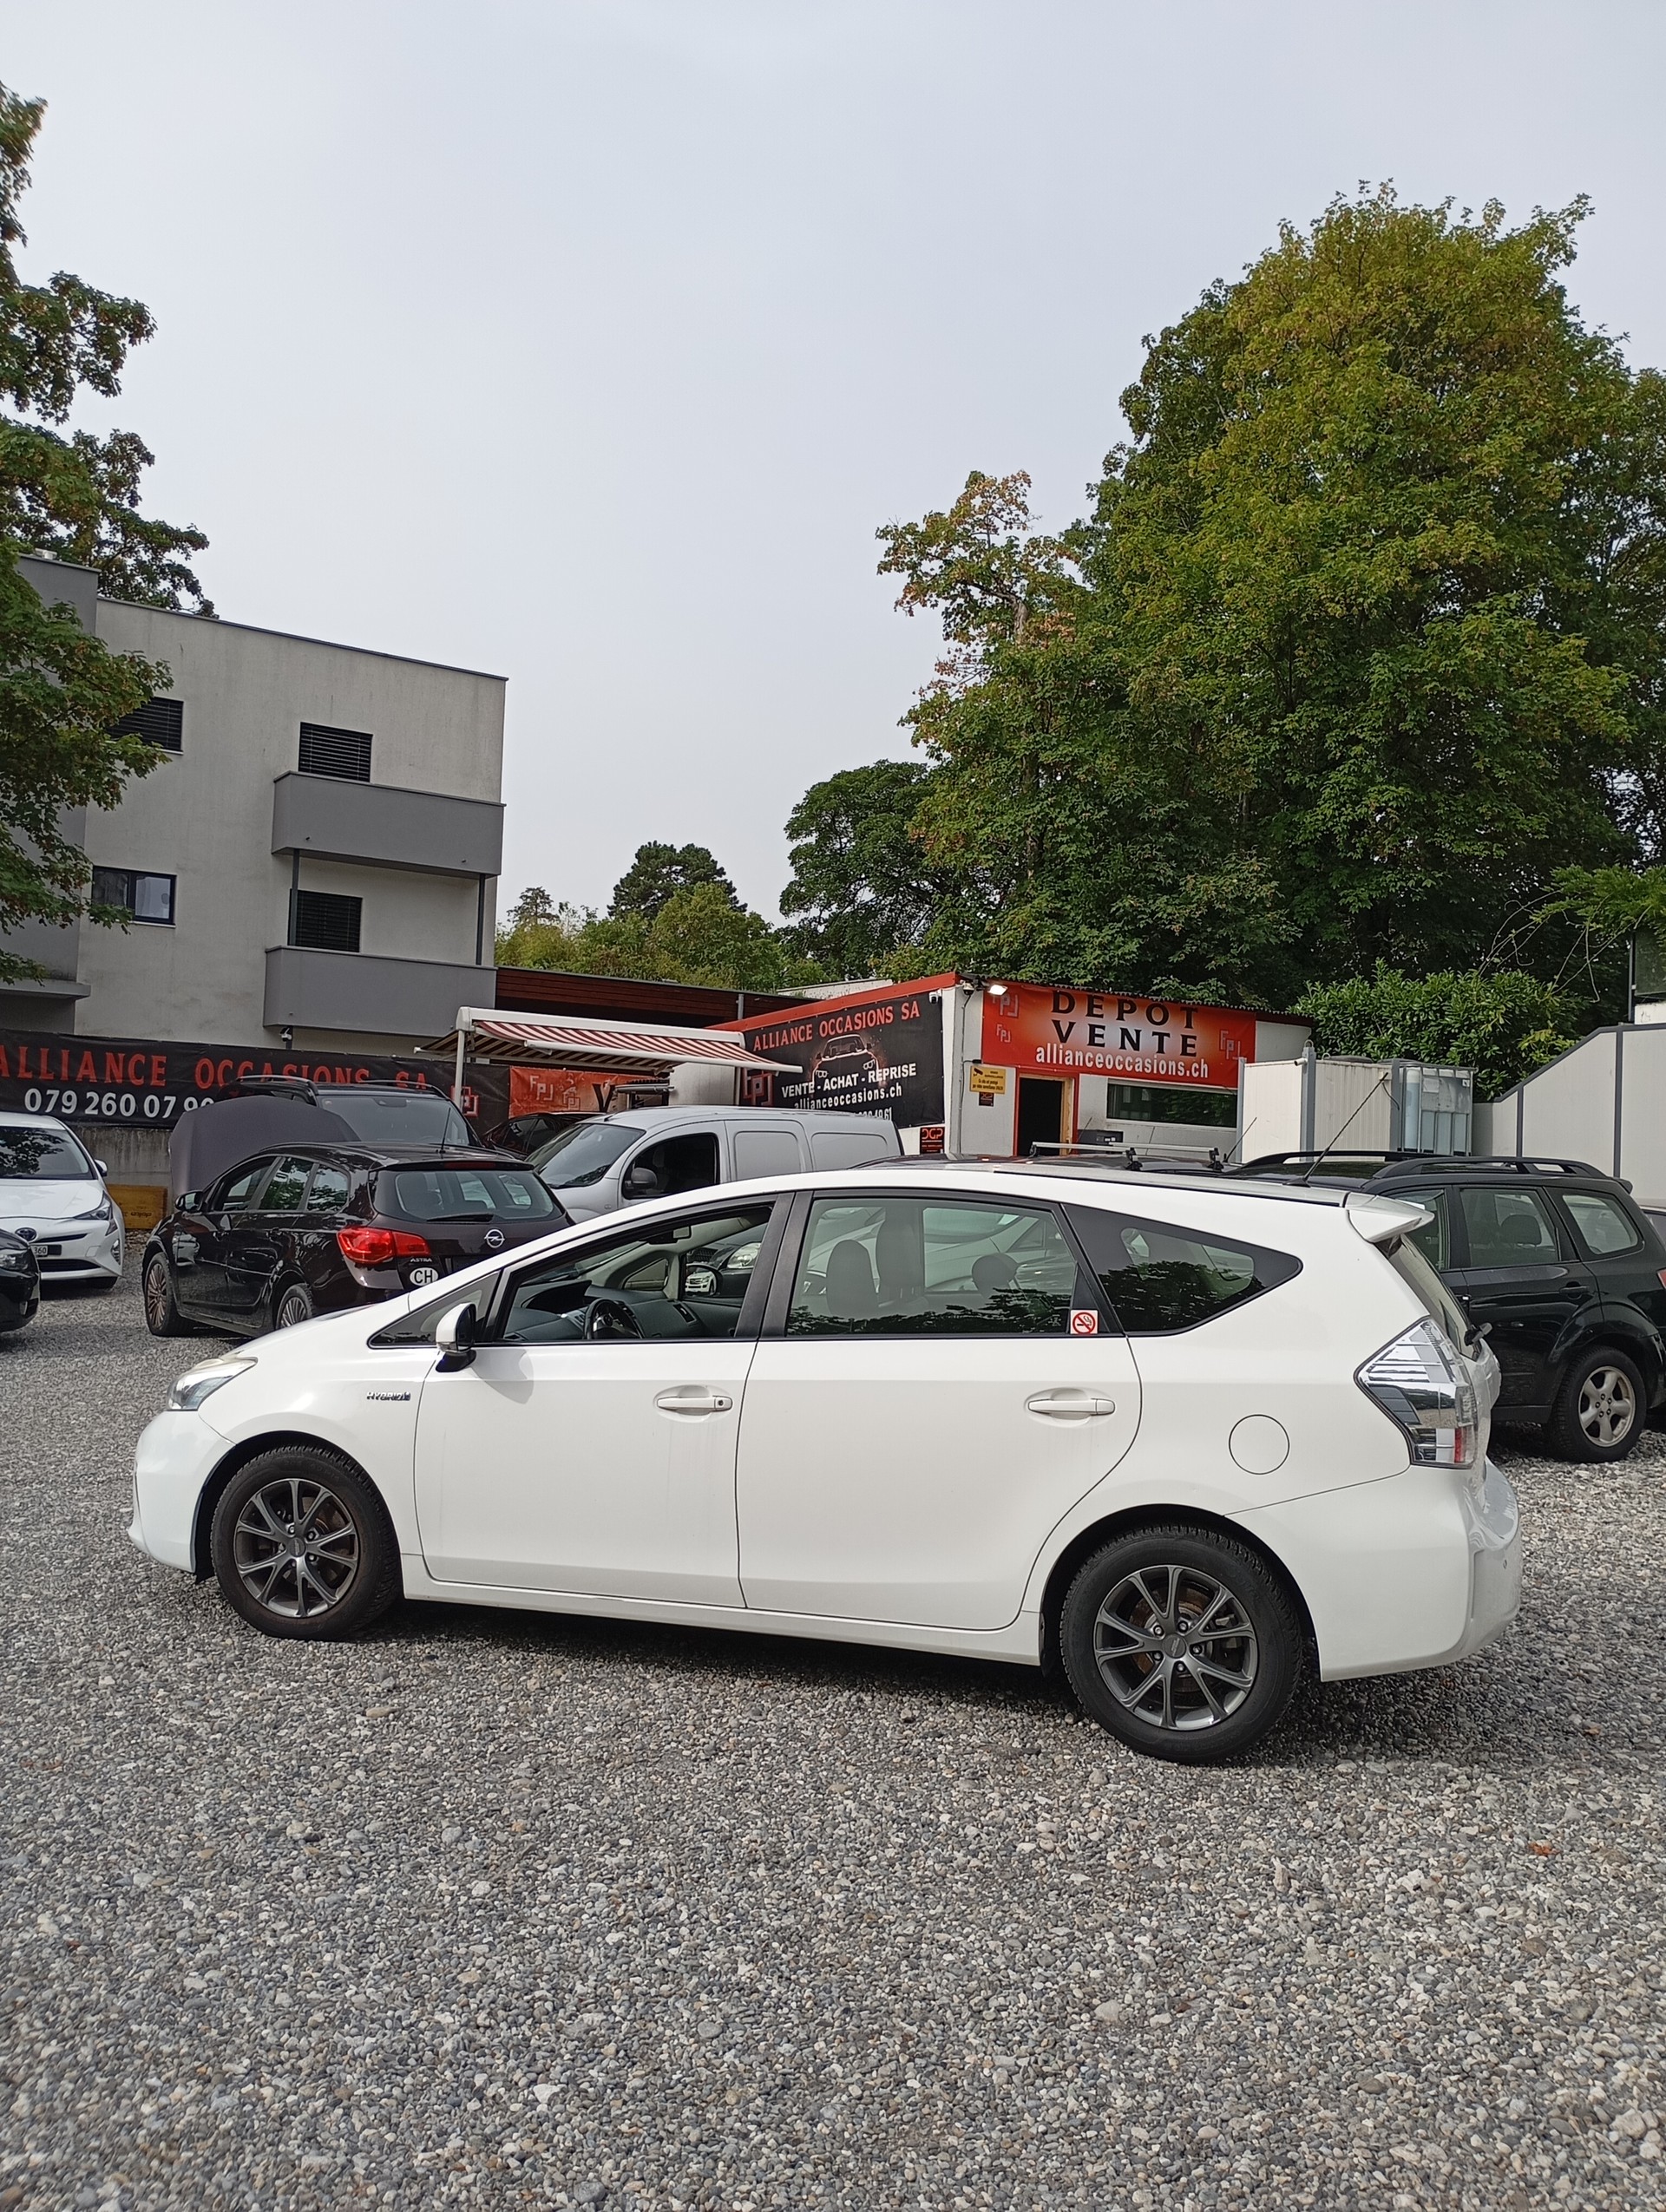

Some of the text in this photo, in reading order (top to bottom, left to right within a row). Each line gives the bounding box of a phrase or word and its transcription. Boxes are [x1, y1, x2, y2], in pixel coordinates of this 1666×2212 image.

[753, 1000, 920, 1052] ALLIANCE OCCASIONS SA
[1052, 991, 1198, 1029] DEPOT
[1052, 1019, 1197, 1057] VENTE
[1035, 1043, 1209, 1078] allianceoccasions.ch
[782, 1082, 815, 1098] VENTE
[823, 1073, 859, 1091] ACHAT
[868, 1063, 916, 1083] REPRISE
[794, 1082, 902, 1110] allianceoccasions.ch
[24, 1088, 78, 1114] 079
[84, 1091, 136, 1116] 260
[143, 1095, 176, 1119] 07
[414, 1269, 433, 1284] CH
